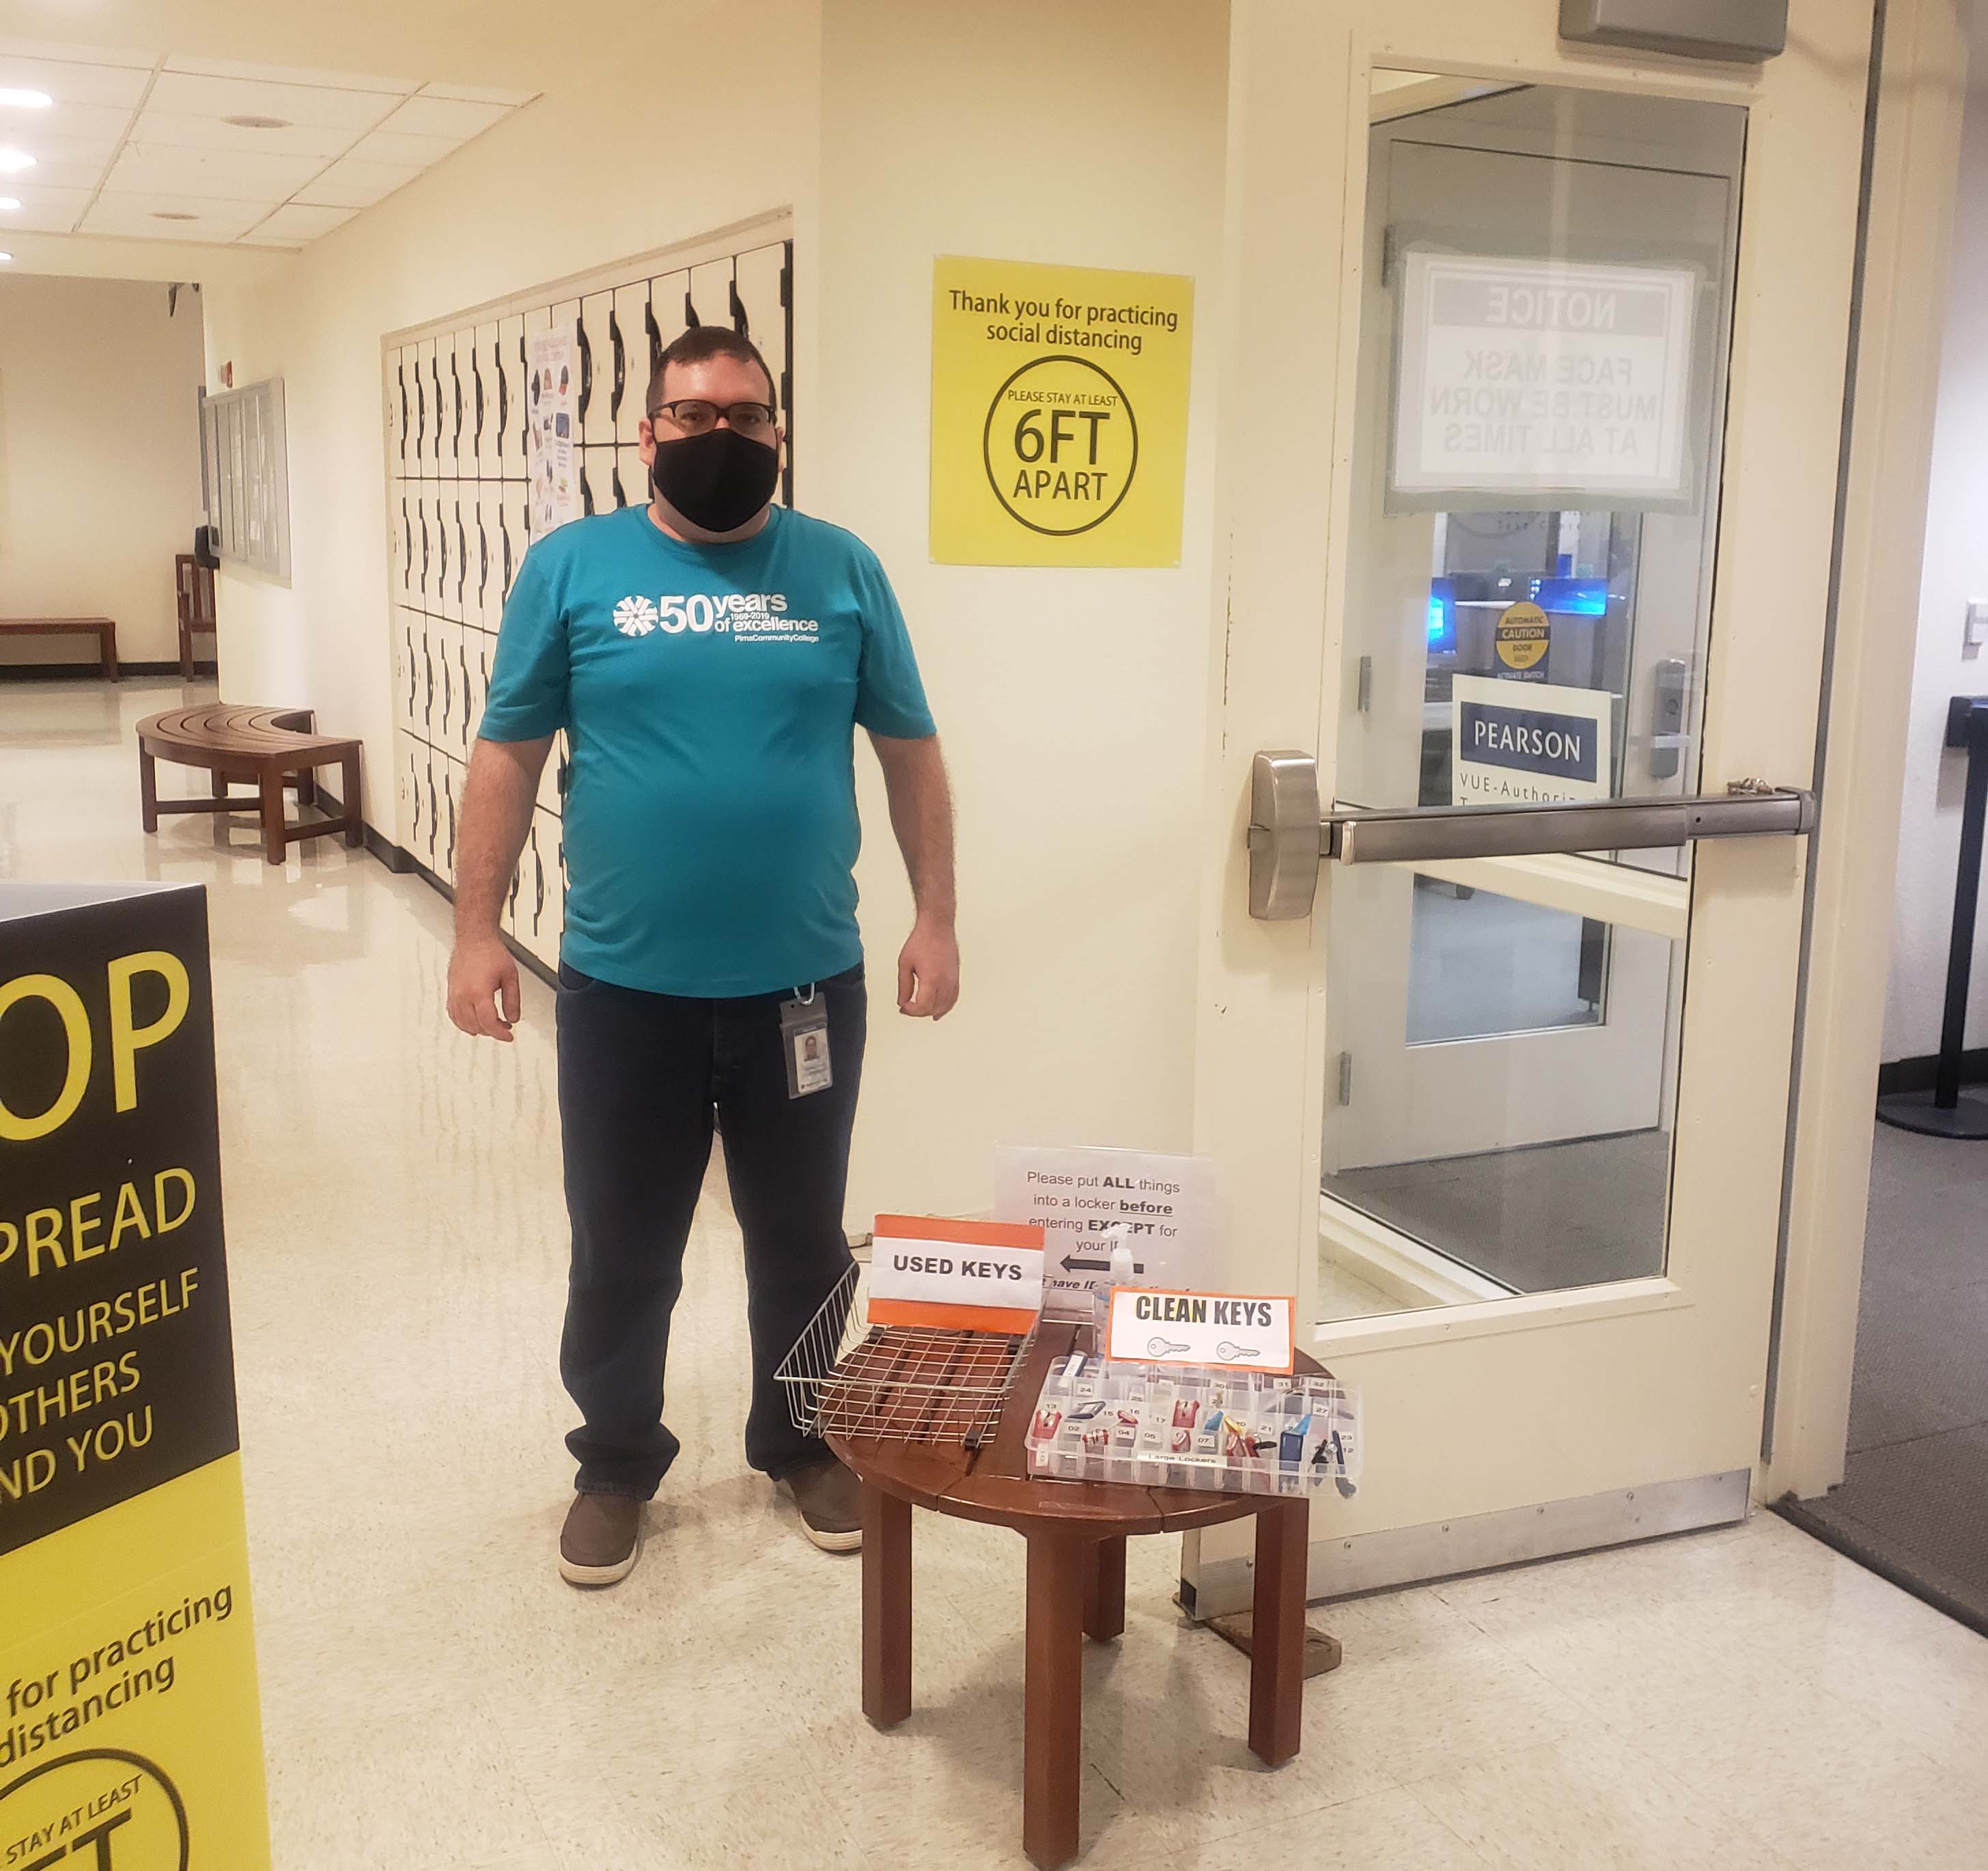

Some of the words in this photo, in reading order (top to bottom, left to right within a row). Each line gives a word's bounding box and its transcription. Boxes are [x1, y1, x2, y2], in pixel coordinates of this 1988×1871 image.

[949, 290, 1010, 315] Thank
[1014, 299, 1050, 321] you
[1056, 298, 1082, 320] for
[1087, 305, 1178, 333] practicing
[987, 322, 1040, 343] social
[1046, 325, 1142, 355] distancing
[1008, 390, 1044, 402] PLEASE
[1046, 392, 1072, 404] STAY
[1073, 394, 1087, 404] AT
[1089, 395, 1117, 406] LEAST
[1013, 408, 1110, 465] 6FT
[1013, 469, 1108, 501] APART
[660, 593, 714, 633] 50
[712, 593, 788, 618] years
[714, 617, 731, 632] of
[733, 616, 818, 632] excellence
[730, 612, 770, 620] 1969-2019
[1502, 628, 1545, 639] CAUTION
[1474, 720, 1580, 763] PEARSON
[1027, 1171, 1073, 1185] Please
[1078, 1176, 1098, 1190] put
[1103, 1177, 1135, 1189] ALL
[1139, 1179, 1180, 1195] things
[1033, 1194, 1058, 1206] into
[1062, 1198, 1070, 1207] a
[1075, 1196, 1115, 1210] locker
[1120, 1200, 1173, 1214] before
[1028, 1218, 1083, 1233] entering
[1159, 1224, 1178, 1237] for
[1076, 1240, 1106, 1252] your
[893, 1254, 954, 1275] USED
[960, 1261, 1022, 1280] KEYS
[1135, 1295, 1207, 1324] CLEAN
[1213, 1301, 1272, 1327] KEYS
[0, 1350, 141, 1441] THERS
[66, 1405, 152, 1473] YOU
[1179, 1454, 1216, 1463] Lockers
[5, 1670, 59, 1718] for
[70, 1585, 233, 1696] practicing
[5, 1823, 55, 1865] STAY
[59, 1807, 83, 1836] AT
[88, 1774, 143, 1820] LEAST
